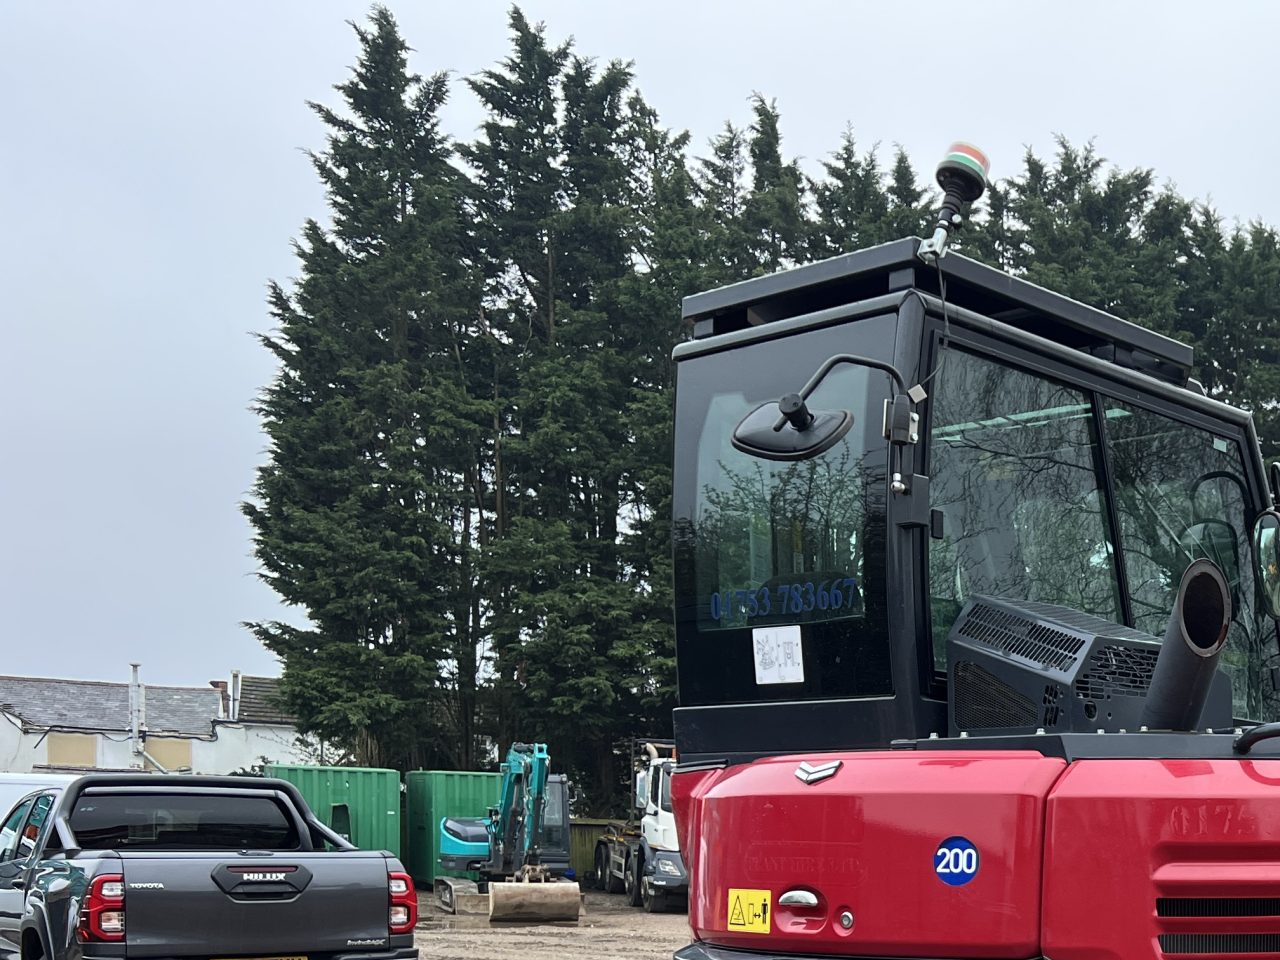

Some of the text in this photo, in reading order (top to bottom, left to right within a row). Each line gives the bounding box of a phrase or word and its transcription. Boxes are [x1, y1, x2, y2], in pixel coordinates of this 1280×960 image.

[778, 578, 856, 615] 783667
[936, 848, 977, 875] 200
[243, 873, 286, 881] HILUX
